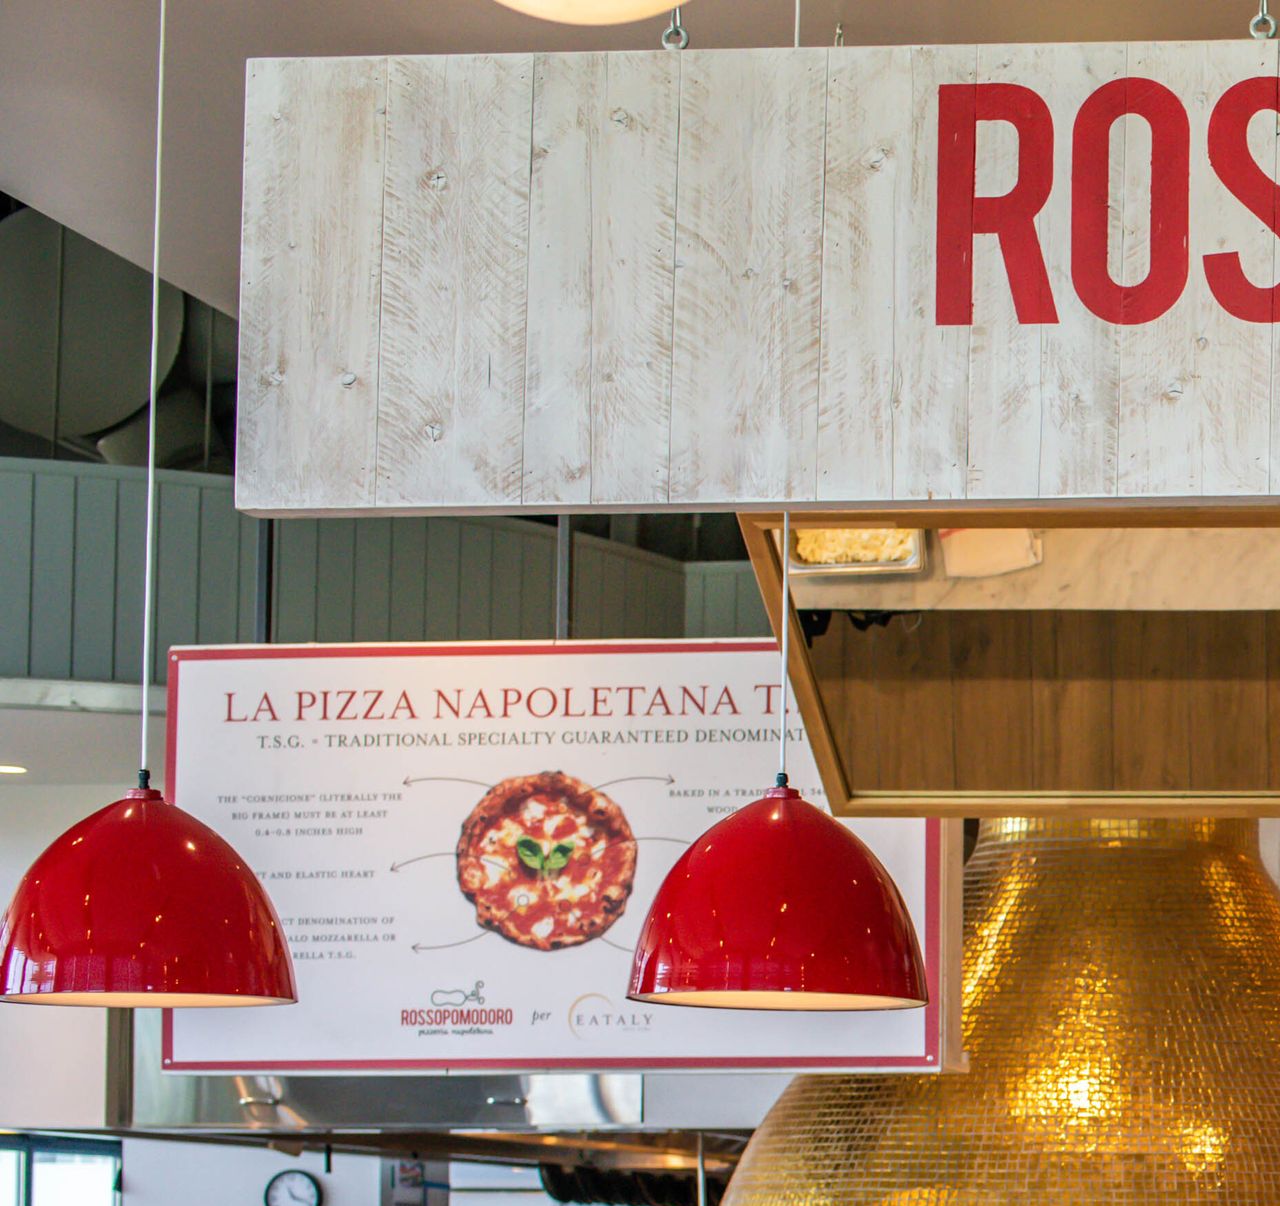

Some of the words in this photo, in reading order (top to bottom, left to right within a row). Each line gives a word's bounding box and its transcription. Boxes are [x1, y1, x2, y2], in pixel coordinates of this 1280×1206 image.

[223, 691, 280, 722] LA
[294, 688, 419, 721] PIZZA
[433, 684, 741, 719] NAPOLETANA
[256, 734, 305, 749] T.S.G.
[324, 732, 452, 748] TRADITIONAL
[457, 730, 556, 746] SPECIALTY
[560, 729, 689, 745] GUARANTEED
[695, 727, 804, 743] DENOMINAT
[217, 794, 238, 804] THE
[381, 792, 402, 801] THE
[668, 788, 705, 798] BAKED
[707, 788, 721, 797] IN
[723, 788, 731, 797] A
[231, 811, 249, 821] BIG
[293, 810, 321, 820] MUST
[324, 810, 337, 819] BE
[340, 810, 353, 819] AT
[356, 809, 388, 819] LEAST
[254, 827, 292, 837] 0.4-0.8
[294, 827, 333, 837] INCHES
[335, 826, 363, 836] HIGH
[269, 870, 293, 880] AND
[294, 870, 337, 880] ELASTIC
[340, 869, 375, 879] HEART
[297, 916, 378, 926] DENOMINATION
[380, 915, 395, 925] OF
[311, 933, 379, 943] MOZZARELLA
[381, 932, 396, 942] OR
[400, 1008, 513, 1026] ROSSOPOMODORO
[531, 1009, 552, 1025] per
[576, 1013, 654, 1026] EATALY
